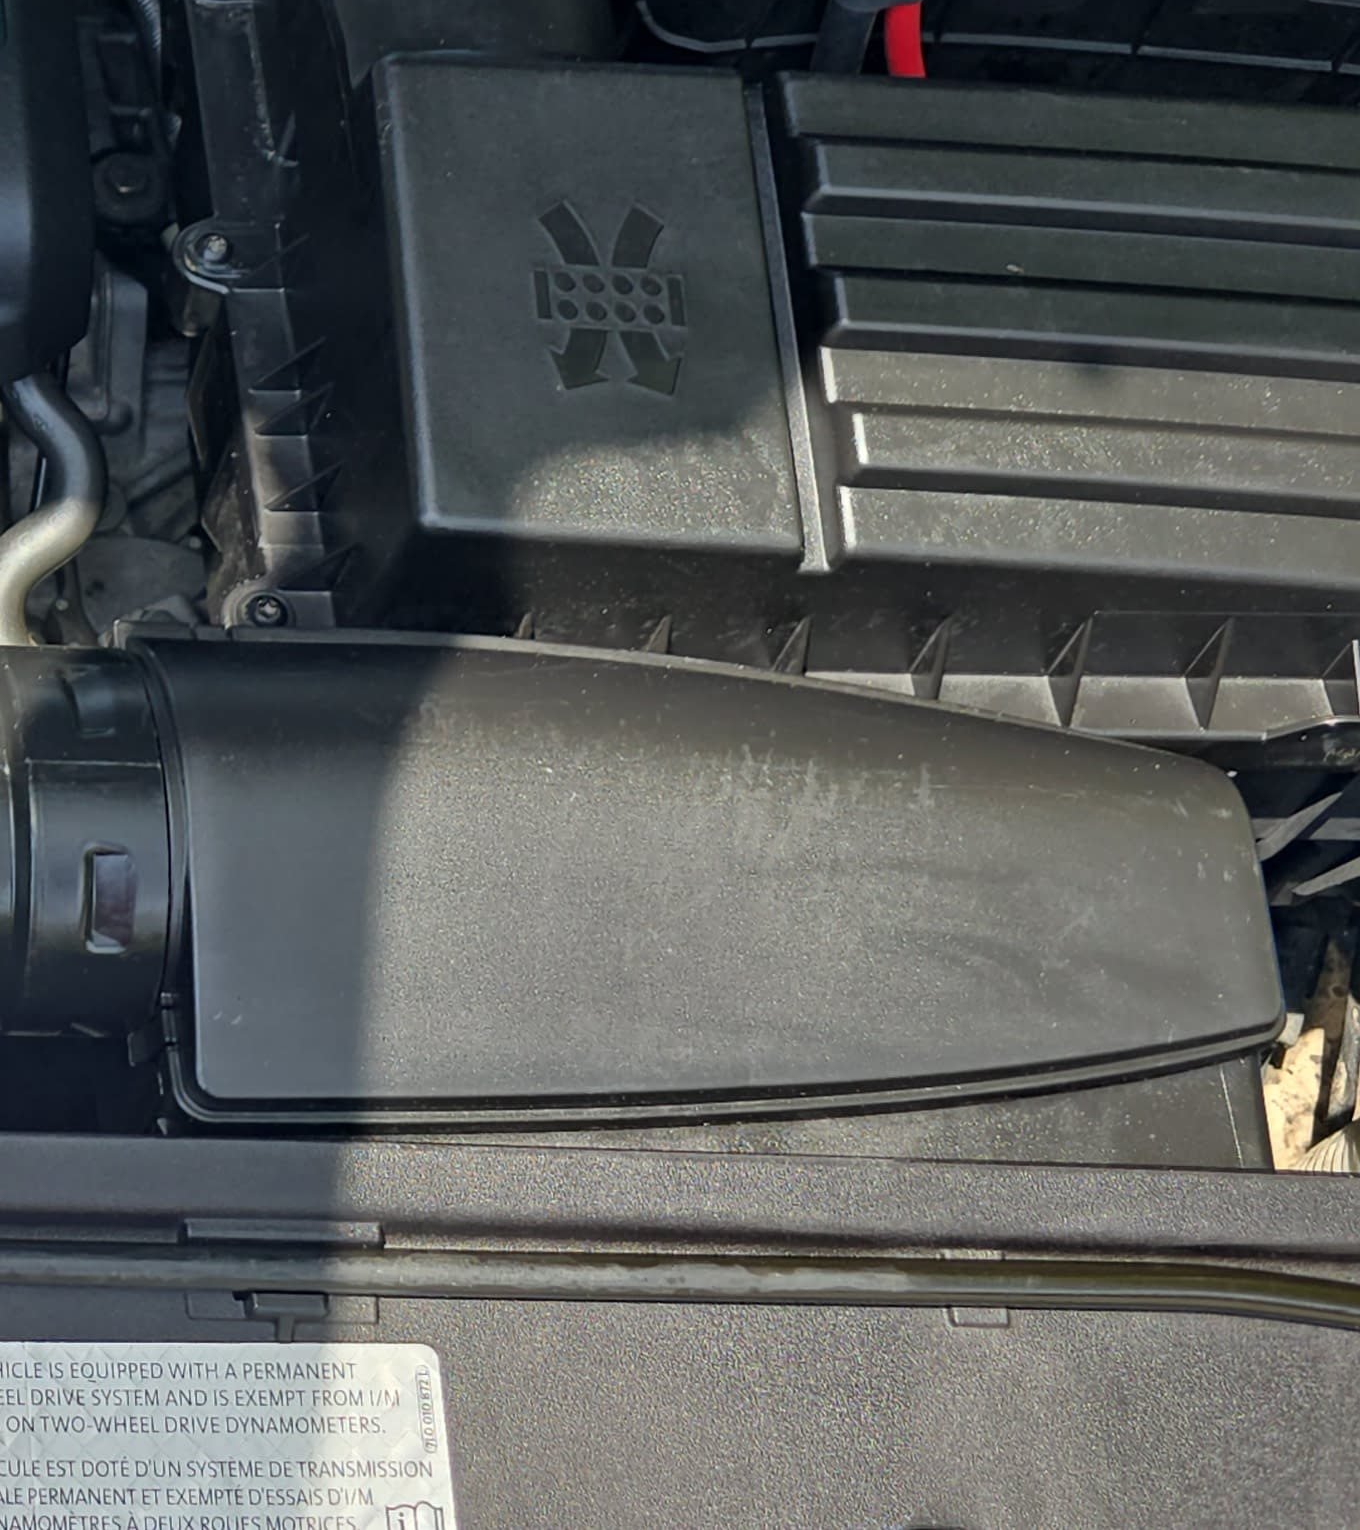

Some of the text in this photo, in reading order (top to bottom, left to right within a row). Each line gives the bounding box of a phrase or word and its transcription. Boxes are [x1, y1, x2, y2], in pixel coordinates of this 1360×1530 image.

[49, 1362, 64, 1379] IS
[70, 1362, 163, 1383] EQUIPPED
[167, 1362, 218, 1380] WITH
[225, 1363, 237, 1380] A
[243, 1362, 357, 1380] PERMANENT
[30, 1388, 85, 1406] DRIVE
[92, 1388, 160, 1406] SYSTEM
[165, 1389, 208, 1406] AND
[214, 1389, 229, 1406] IS
[235, 1389, 306, 1407] EXEMPT
[312, 1389, 364, 1407] FROM
[369, 1390, 400, 1407] I/M
[6, 1416, 35, 1433] ON
[40, 1416, 160, 1433] TWO-WHEEL
[165, 1416, 220, 1434] DRIVE
[226, 1416, 386, 1434] DYNAMOMETERS.
[47, 1459, 76, 1477] EST
[82, 1455, 130, 1478] DOTÉ
[135, 1459, 181, 1478] D'UN
[187, 1456, 262, 1478] SYSTÈME
[269, 1460, 292, 1478] DE
[297, 1461, 433, 1479] TRANSMISSION
[30, 1487, 136, 1505] PERMANENT
[142, 1488, 161, 1505] ET
[166, 1484, 244, 1506] EXEMPTÉ
[249, 1488, 323, 1506] D'ESSAIS
[329, 1488, 374, 1506] D'I/M
[127, 1510, 139, 1530] À
[145, 1515, 194, 1530] DEUX
[201, 1516, 261, 1530] ROUES
[266, 1516, 360, 1530] MOTRICES.
